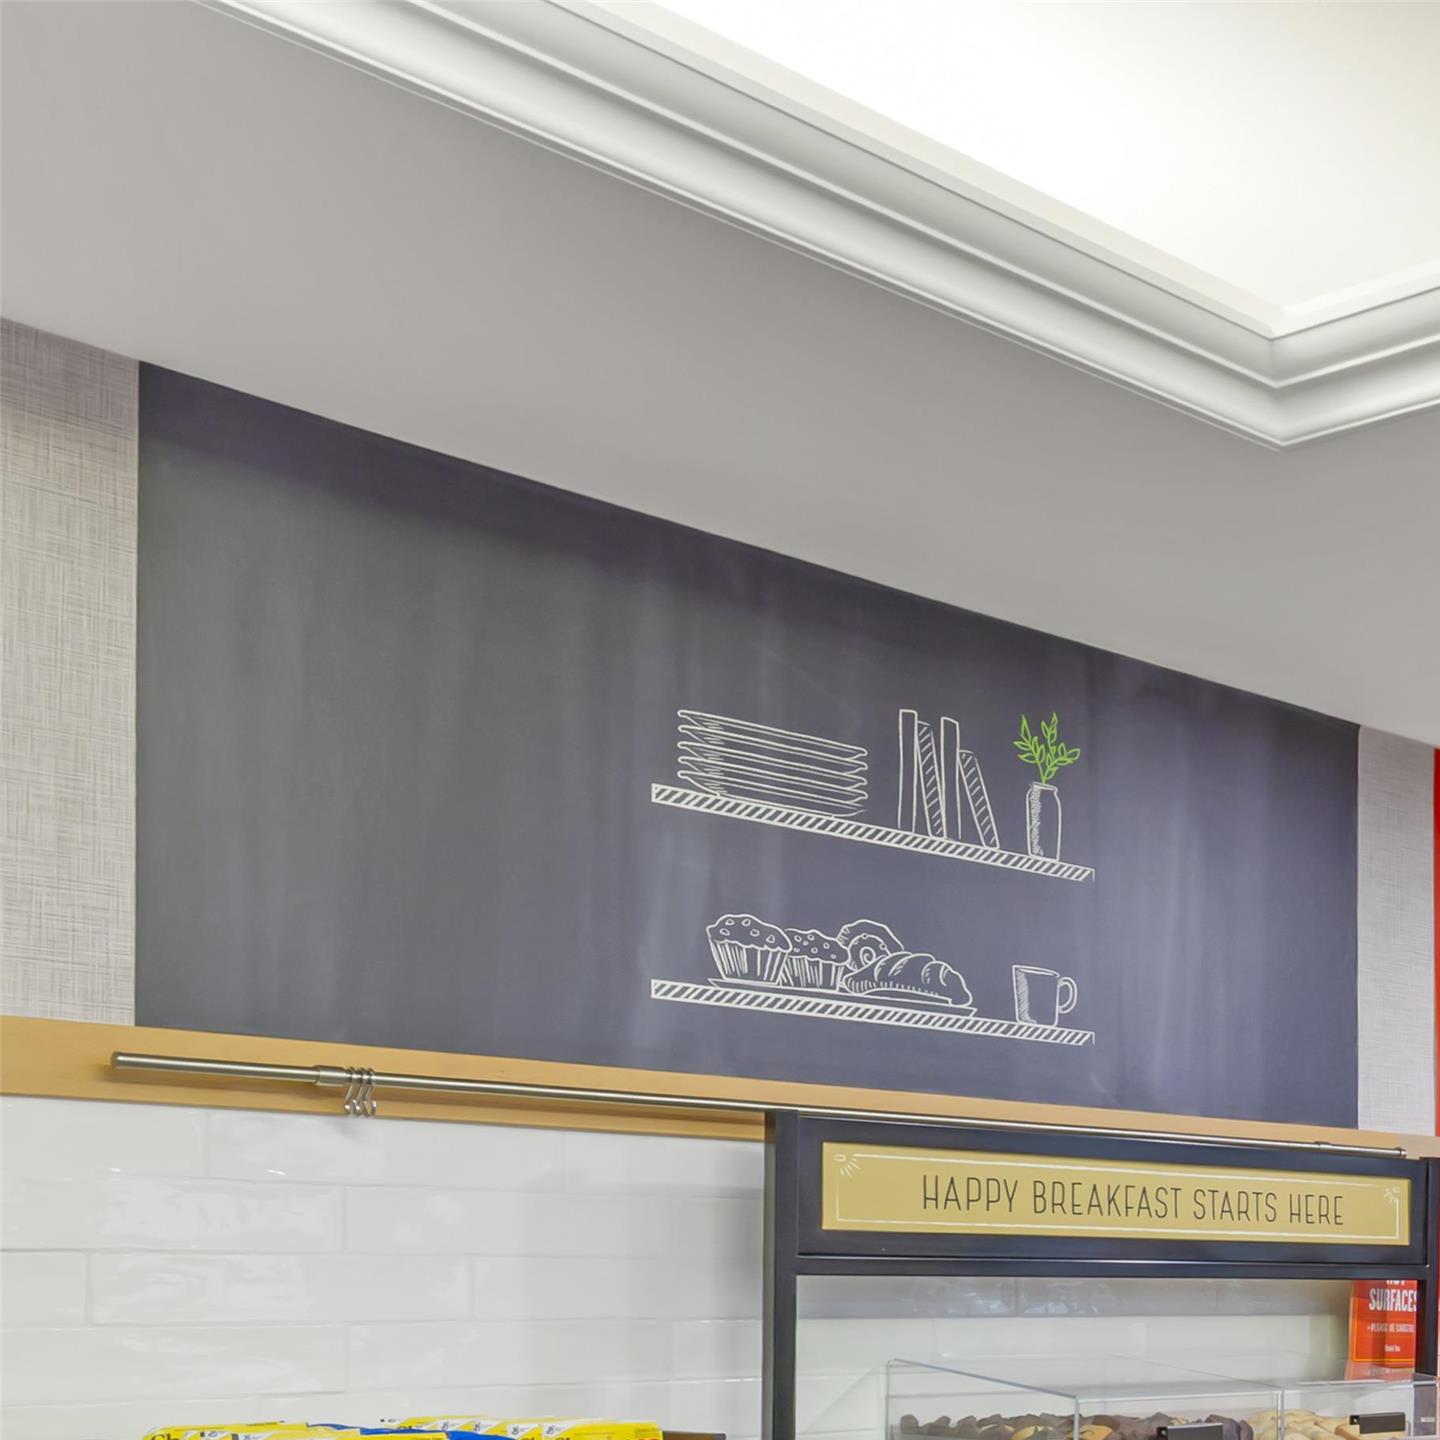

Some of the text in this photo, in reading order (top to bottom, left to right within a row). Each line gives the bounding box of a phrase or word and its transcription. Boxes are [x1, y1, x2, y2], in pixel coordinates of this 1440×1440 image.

[922, 1174, 1344, 1226] HAPPY BREAKFAST STARTS HERE
